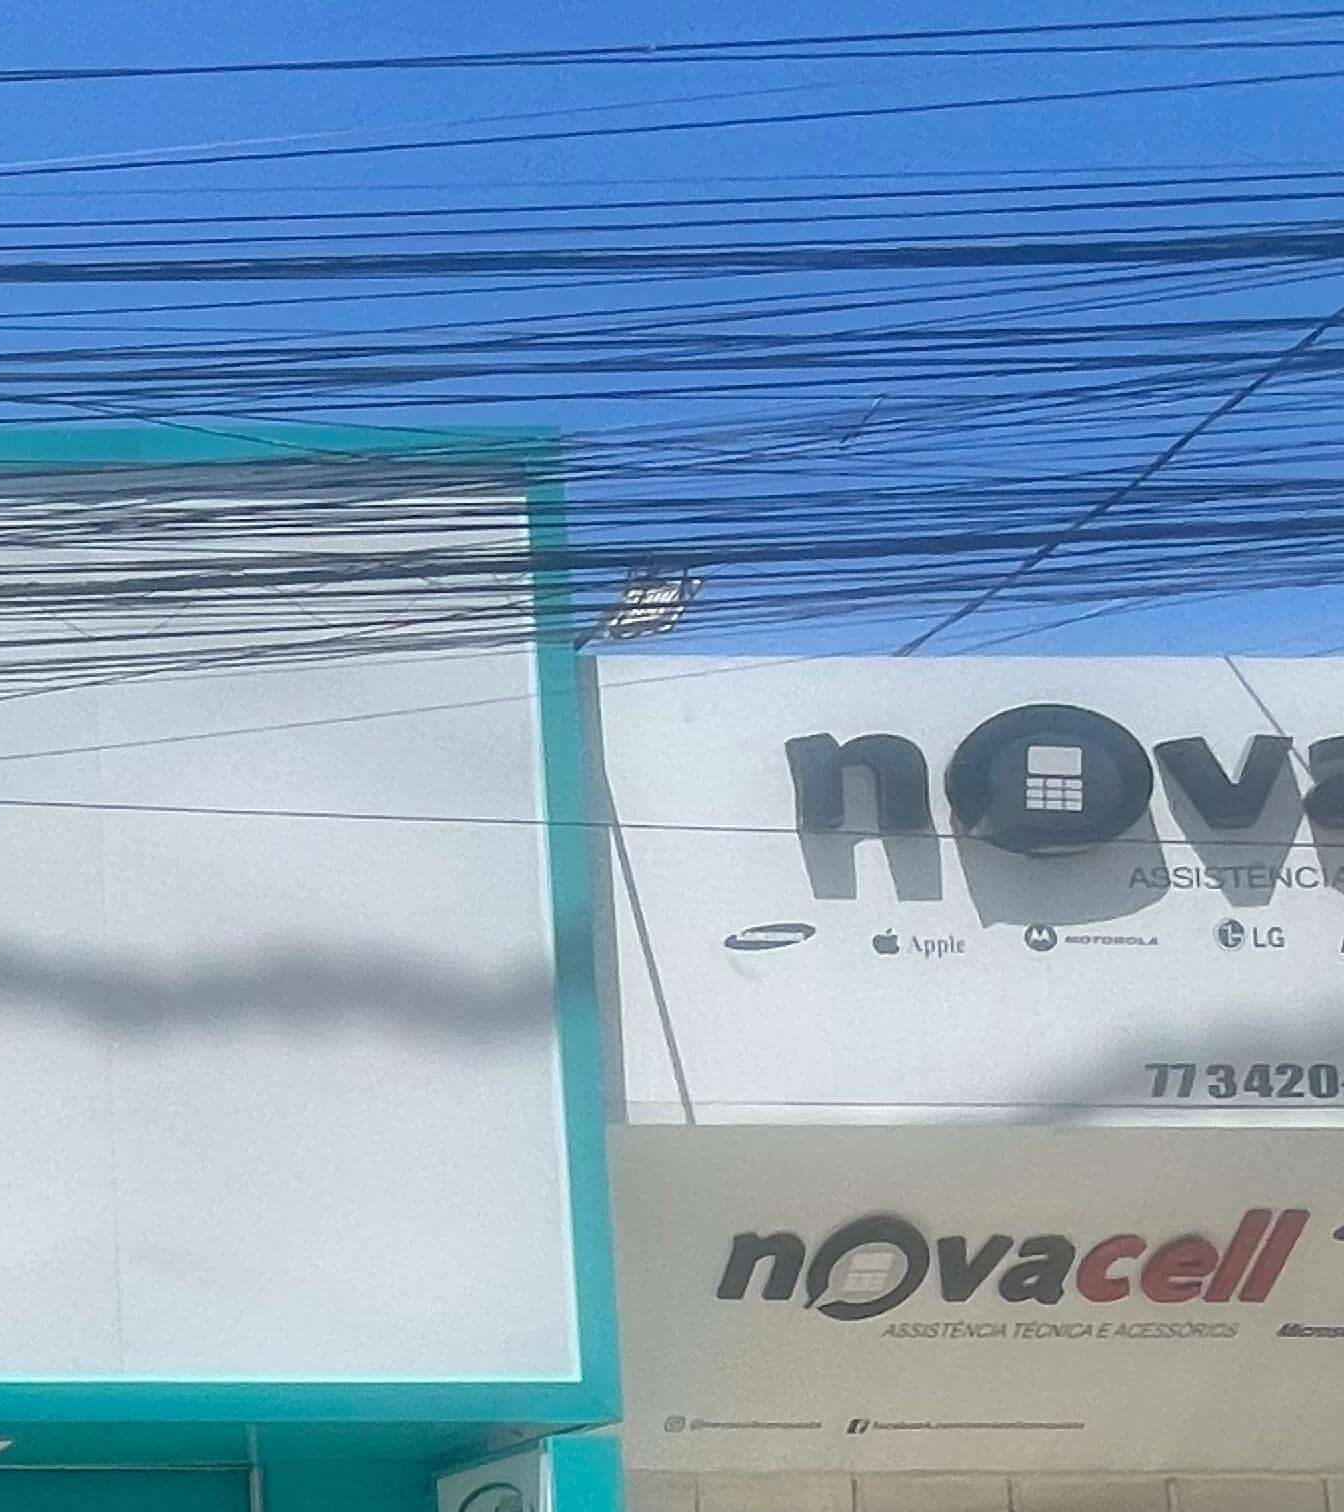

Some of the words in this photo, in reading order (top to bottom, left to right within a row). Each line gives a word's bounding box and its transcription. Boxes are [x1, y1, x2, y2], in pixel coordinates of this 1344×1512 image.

[907, 934, 966, 960] Apple
[1252, 926, 1286, 948] LG
[1095, 1321, 1113, 1338] E
